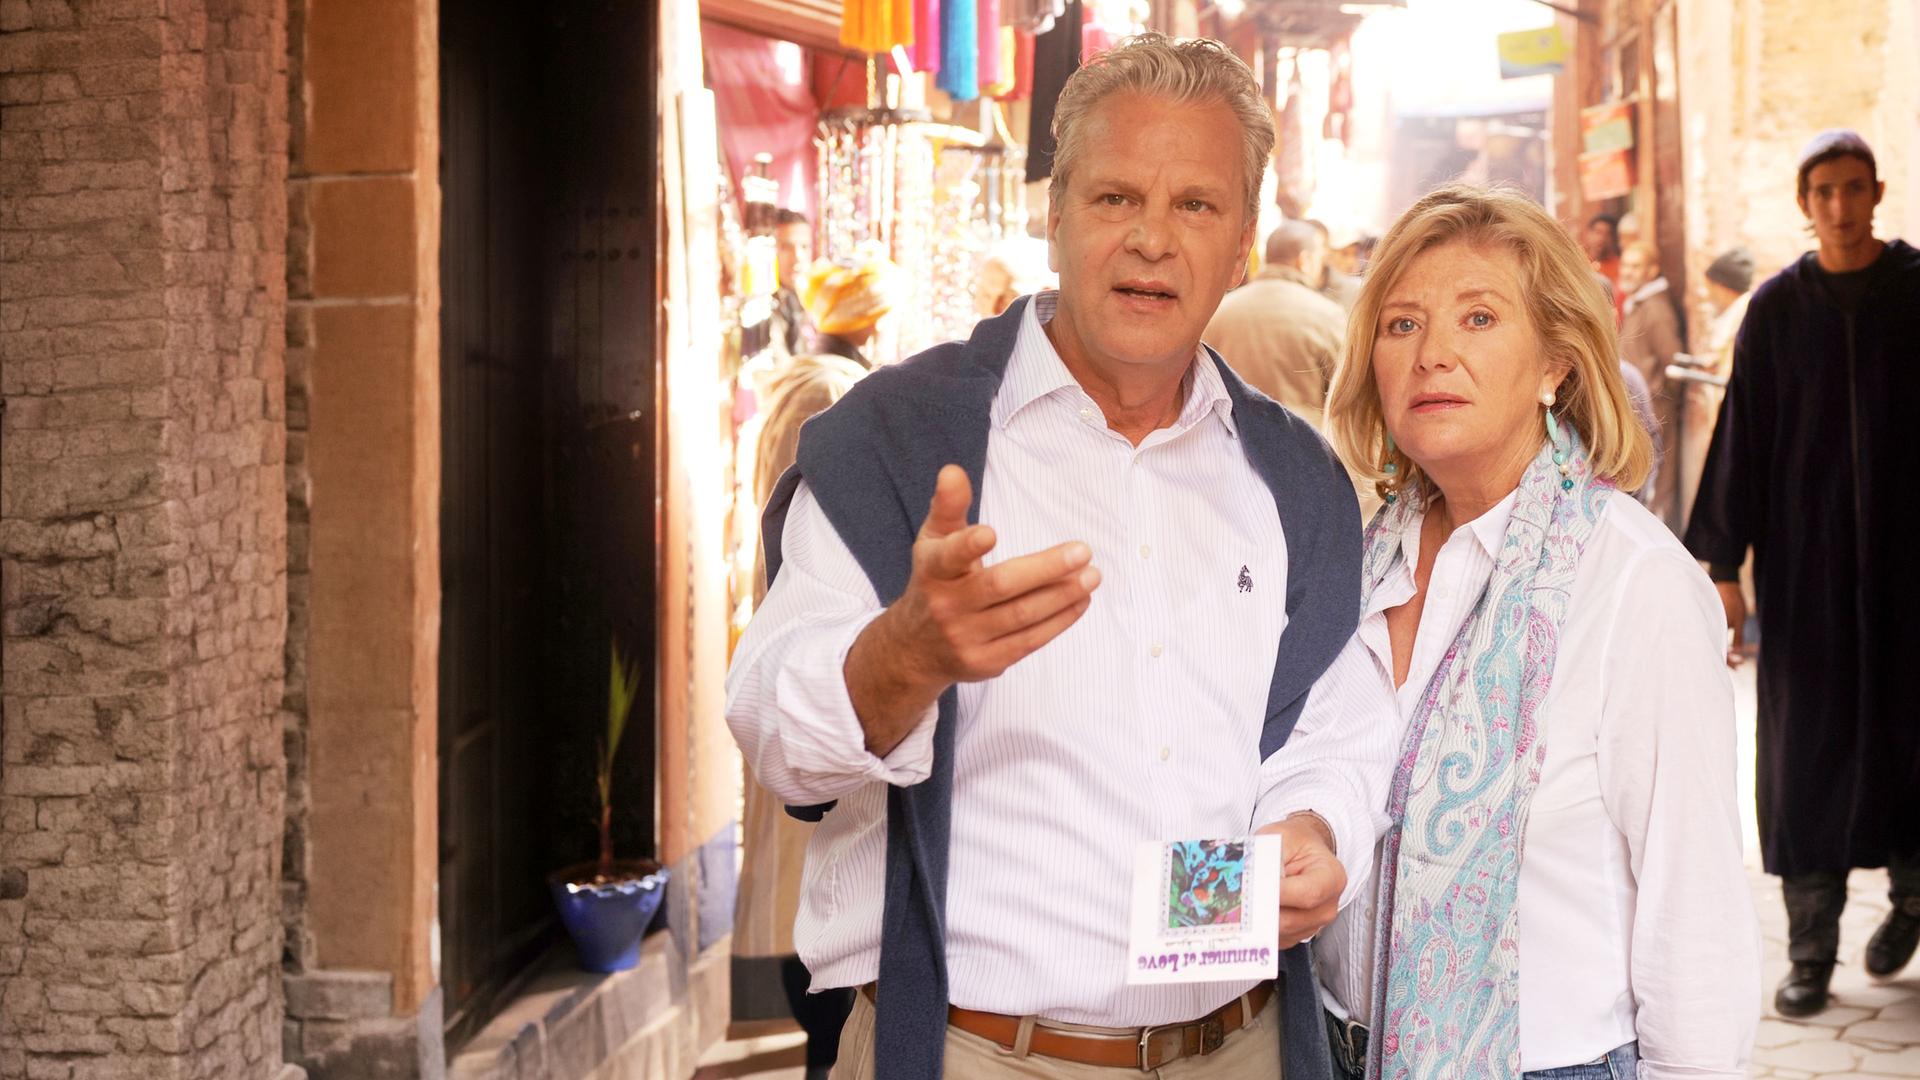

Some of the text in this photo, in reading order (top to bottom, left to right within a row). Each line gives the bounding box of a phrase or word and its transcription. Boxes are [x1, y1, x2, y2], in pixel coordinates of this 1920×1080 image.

[1137, 948, 1270, 972] Summer of Love
